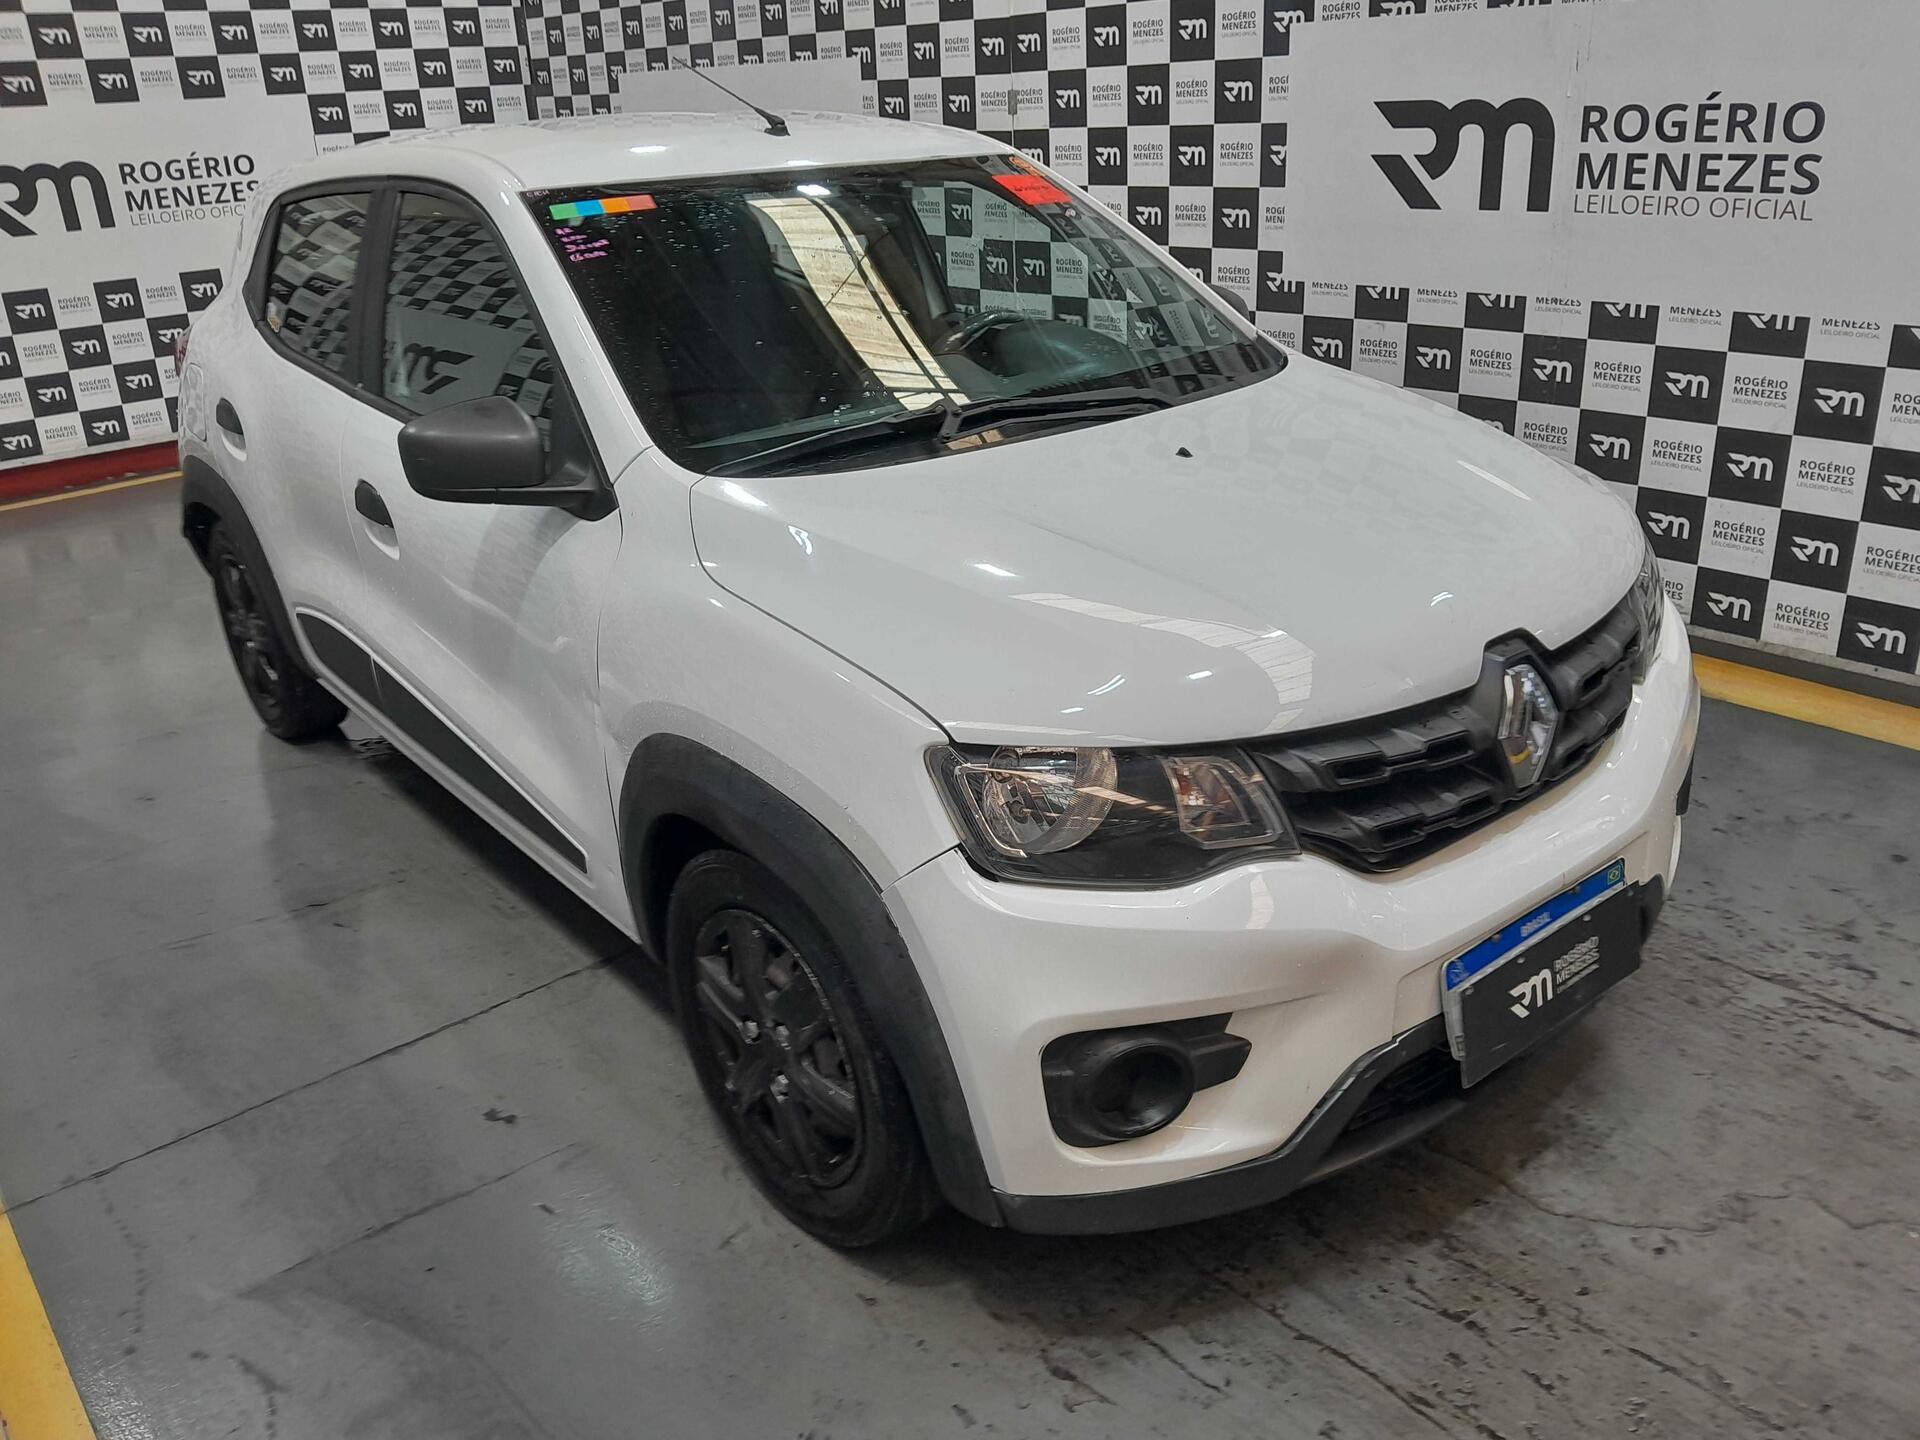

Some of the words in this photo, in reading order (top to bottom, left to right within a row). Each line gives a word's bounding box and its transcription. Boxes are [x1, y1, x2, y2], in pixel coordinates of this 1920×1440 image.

[1322, 2, 1360, 13] ROGÉRIO
[1222, 11, 1256, 21] ROGÉRIO
[1133, 19, 1164, 29] ROGÉRIO
[1222, 20, 1256, 29] MENEZES
[1053, 26, 1080, 36] ROGÉRIO
[1133, 28, 1164, 37] MENEZES
[945, 36, 969, 46] ROGÉRIO
[1053, 35, 1080, 45] MENEZES
[1093, 84, 1121, 93] ROGÉRIO
[1176, 80, 1208, 89] ROGÉRIO
[914, 93, 937, 101] ROGÉRIO
[981, 91, 1006, 99] ROGÉRIO
[1017, 88, 1043, 97] ROGÉRIO
[1093, 93, 1121, 102] MENEZES
[1176, 89, 1208, 97] MENEZES
[981, 98, 1007, 106] MENEZES
[1017, 96, 1043, 105] MENEZES
[1579, 91, 1826, 144] ROGÉRIO
[1054, 143, 1083, 152] ROGÉRIO
[1134, 142, 1163, 152] ROGÉRIO
[1220, 142, 1254, 151] ROGÉRIO
[1055, 151, 1083, 160] MENEZES
[118, 152, 255, 184] ROGÉRIO
[1576, 152, 1823, 196] MENEZES
[1176, 204, 1207, 213] ROGÉRIO
[1573, 194, 1700, 219] LEILOEIRO
[1709, 196, 1814, 222] OFICIAL
[130, 208, 206, 226] LEILOEIRO
[1218, 266, 1250, 276] ROGÉRIO
[1218, 275, 1250, 283] MENEZES
[1360, 338, 1398, 350] ROGÉRIO
[1359, 347, 1397, 359] MENEZES
[1470, 348, 1512, 361] ROGÉRIO
[1469, 358, 1512, 371] MENEZES
[1594, 361, 1642, 374] ROGÉRIO
[1593, 371, 1641, 384] MENEZES
[1735, 375, 1788, 390] ROGÉRIO
[1733, 386, 1787, 400] MENEZES
[1524, 421, 1568, 436] ROGÉRIO
[1523, 431, 1568, 445] MENEZES
[1653, 439, 1703, 454] ROGÉRIO
[1652, 449, 1702, 464] MENEZES
[1800, 459, 1856, 476] ROGÉRIO
[1798, 470, 1854, 487] MENEZES
[1714, 519, 1766, 536] ROGÉRIO
[1712, 529, 1765, 547] MENEZES
[1776, 602, 1830, 621] ROGÉRIO
[1774, 612, 1829, 631] MENEZES
